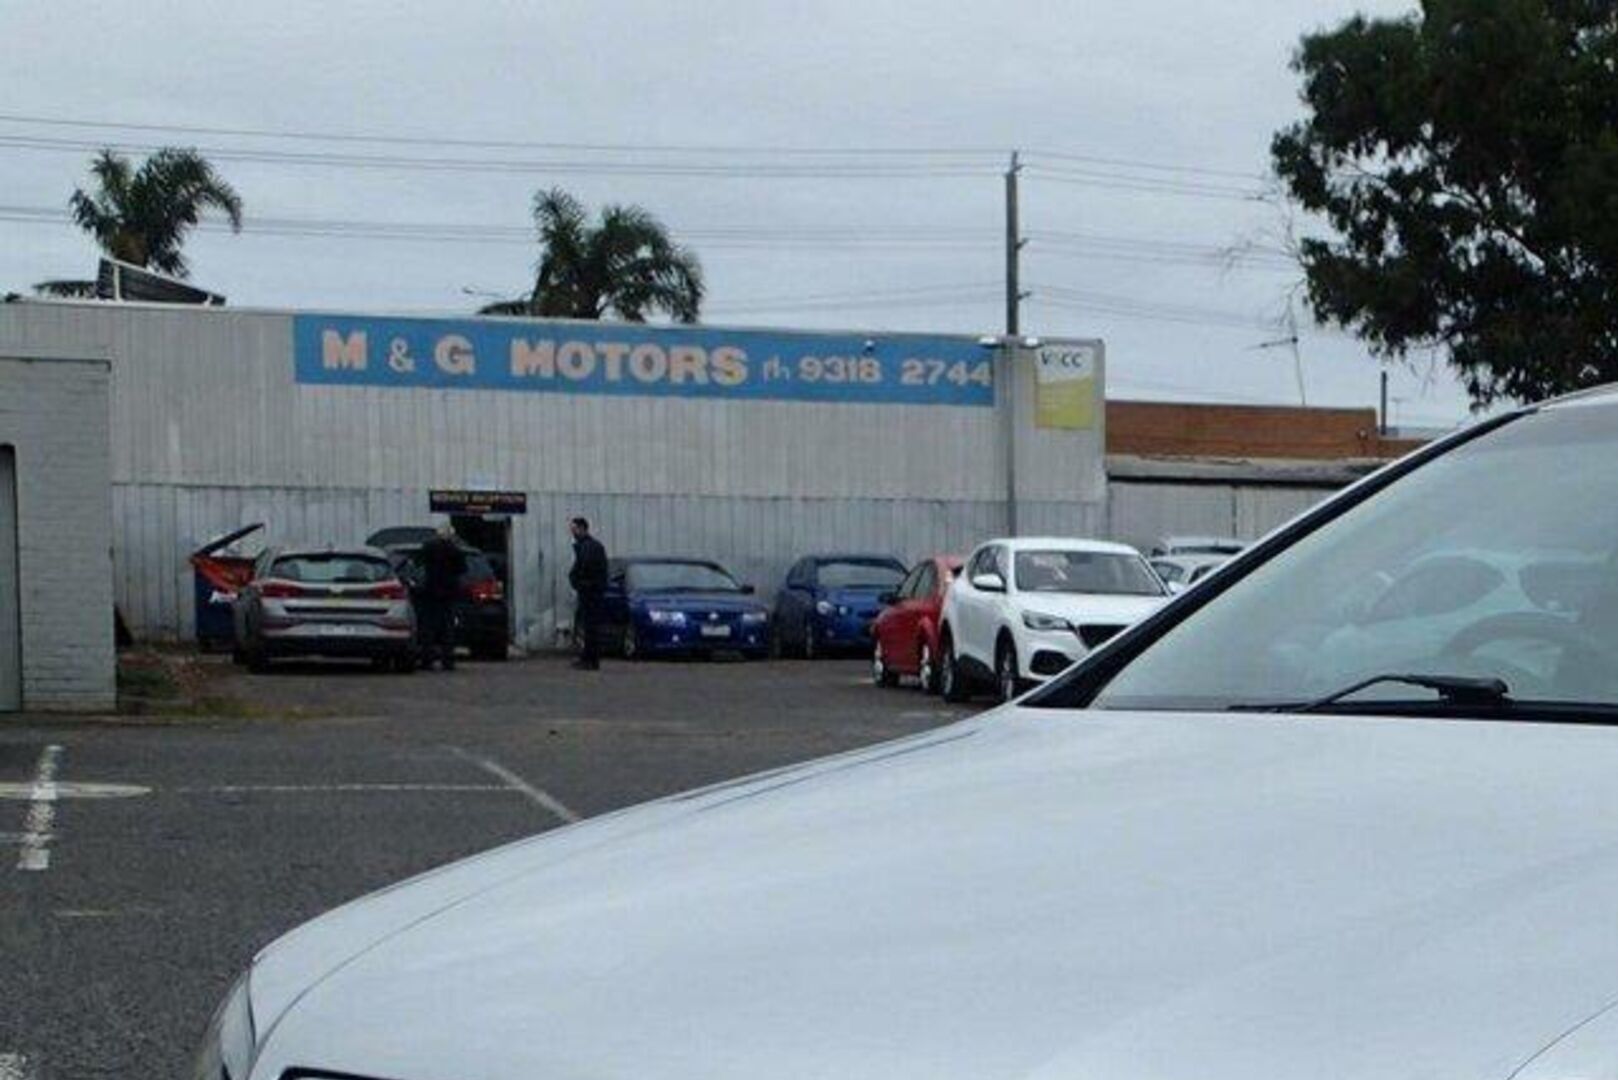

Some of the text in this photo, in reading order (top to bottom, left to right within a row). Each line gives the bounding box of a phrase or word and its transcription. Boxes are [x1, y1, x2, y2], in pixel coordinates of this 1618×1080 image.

[322, 330, 367, 370] M
[388, 339, 415, 373] &
[435, 334, 476, 375] G
[510, 338, 748, 385] MOTORS
[800, 355, 880, 383] 9318
[901, 359, 993, 386] 2744
[1041, 351, 1082, 368] VCC
